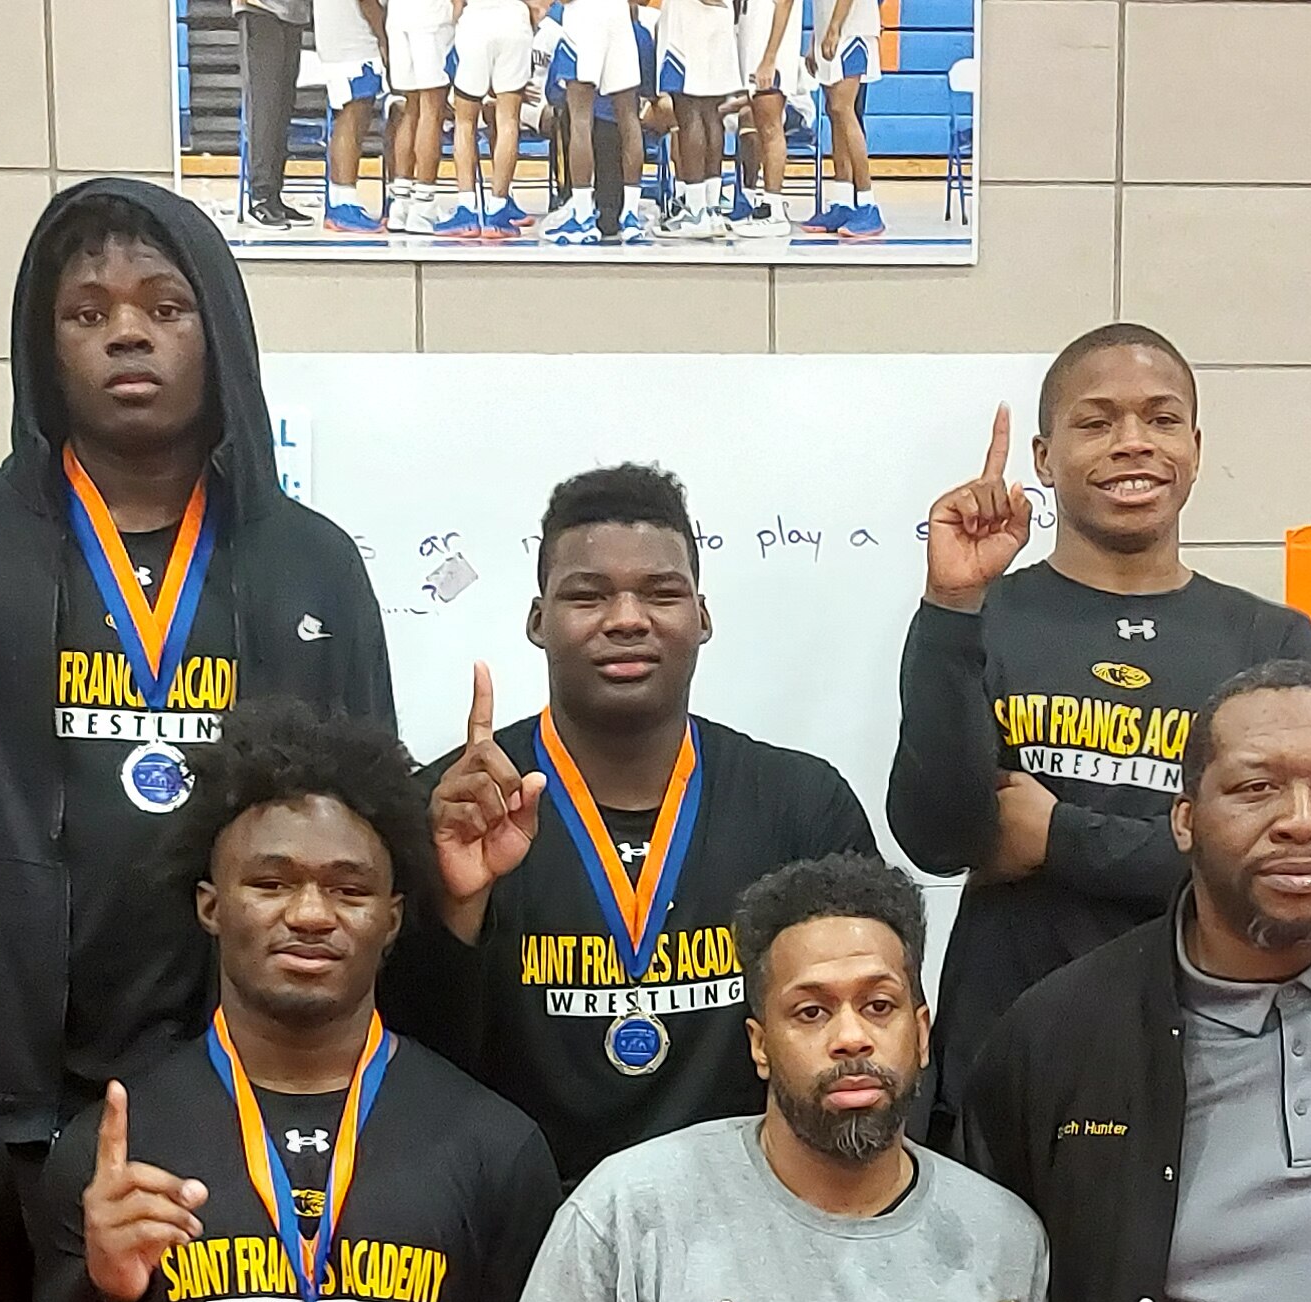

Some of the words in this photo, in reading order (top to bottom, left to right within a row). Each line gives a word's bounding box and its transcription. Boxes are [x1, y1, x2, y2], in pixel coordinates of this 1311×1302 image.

[756, 514, 822, 563] play
[849, 528, 879, 547] a
[61, 711, 221, 740] RESTLIN
[1049, 695, 1143, 756] FRANCES
[1024, 749, 1181, 790] WRESTLIN
[550, 980, 742, 1014] WRESTLING
[1083, 1119, 1129, 1136] Hunter
[160, 1238, 230, 1302] SAINT
